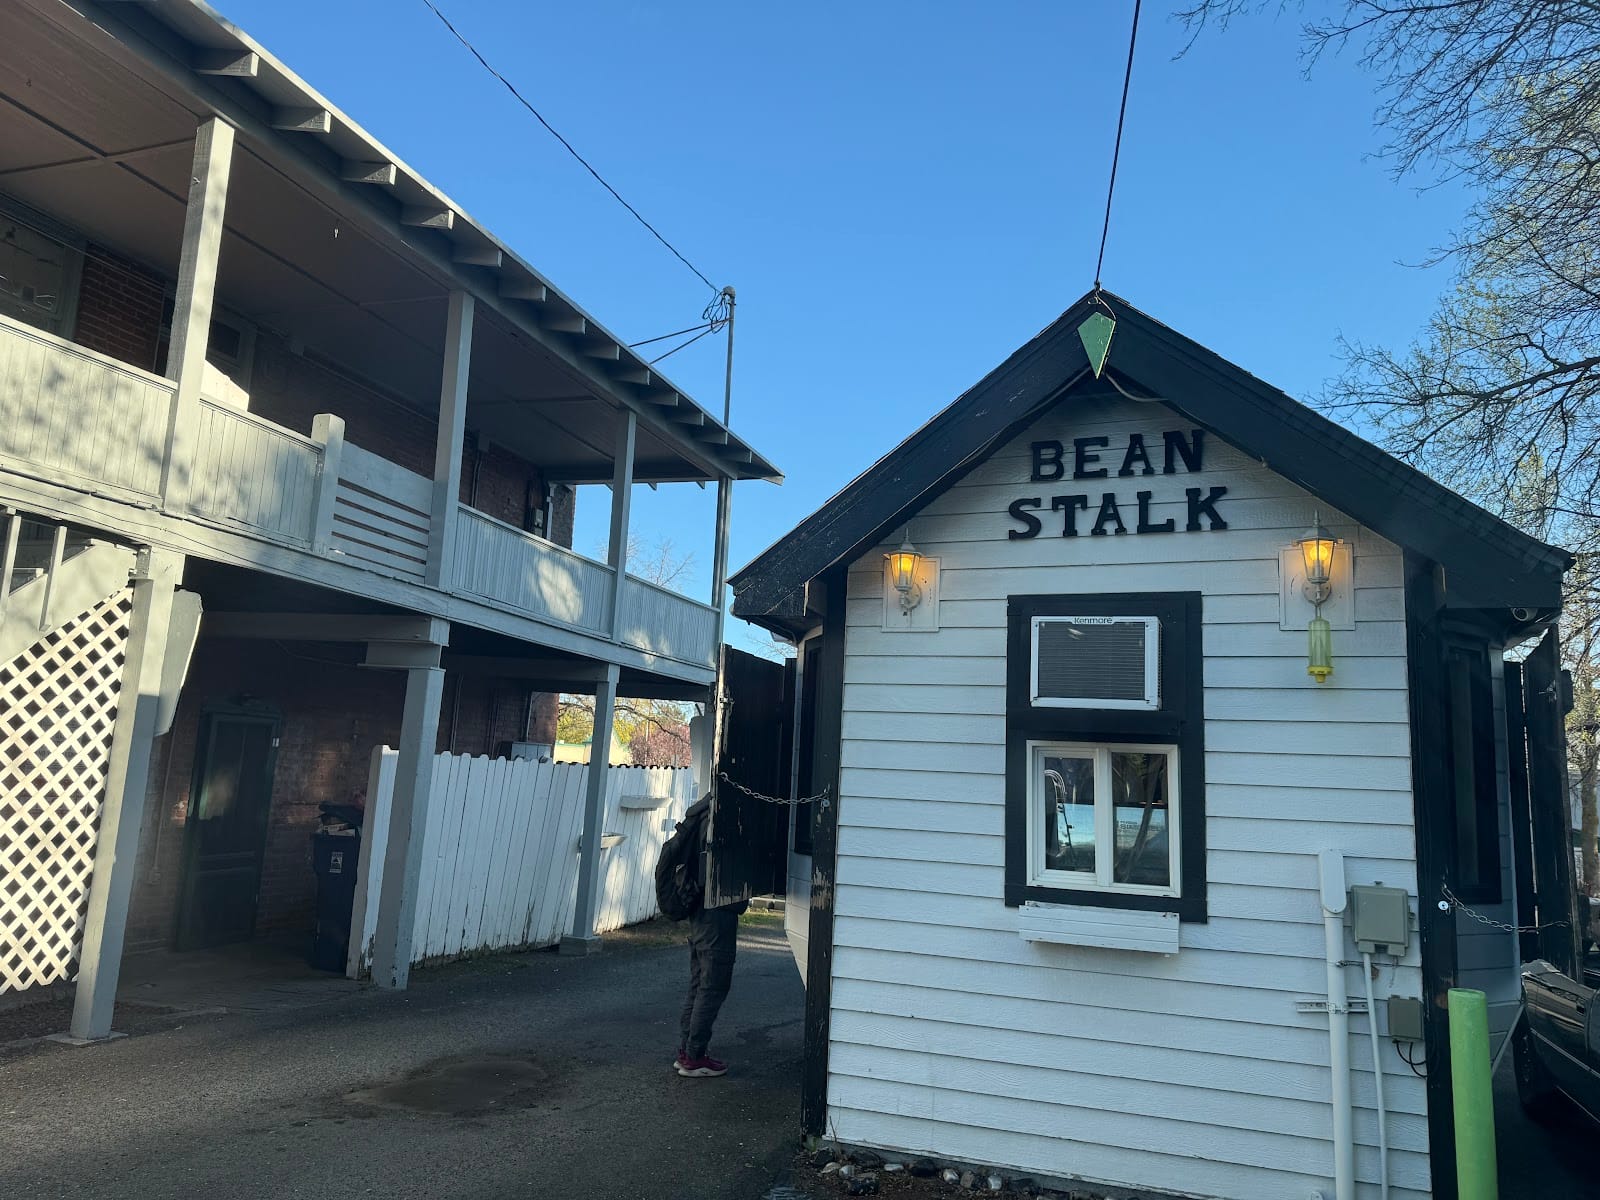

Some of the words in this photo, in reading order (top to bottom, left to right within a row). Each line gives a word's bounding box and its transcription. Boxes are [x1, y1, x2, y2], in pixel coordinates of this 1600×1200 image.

[1030, 429, 1205, 481] BEAN
[1008, 486, 1228, 540] STALK
[1074, 616, 1113, 624] Kenmore
